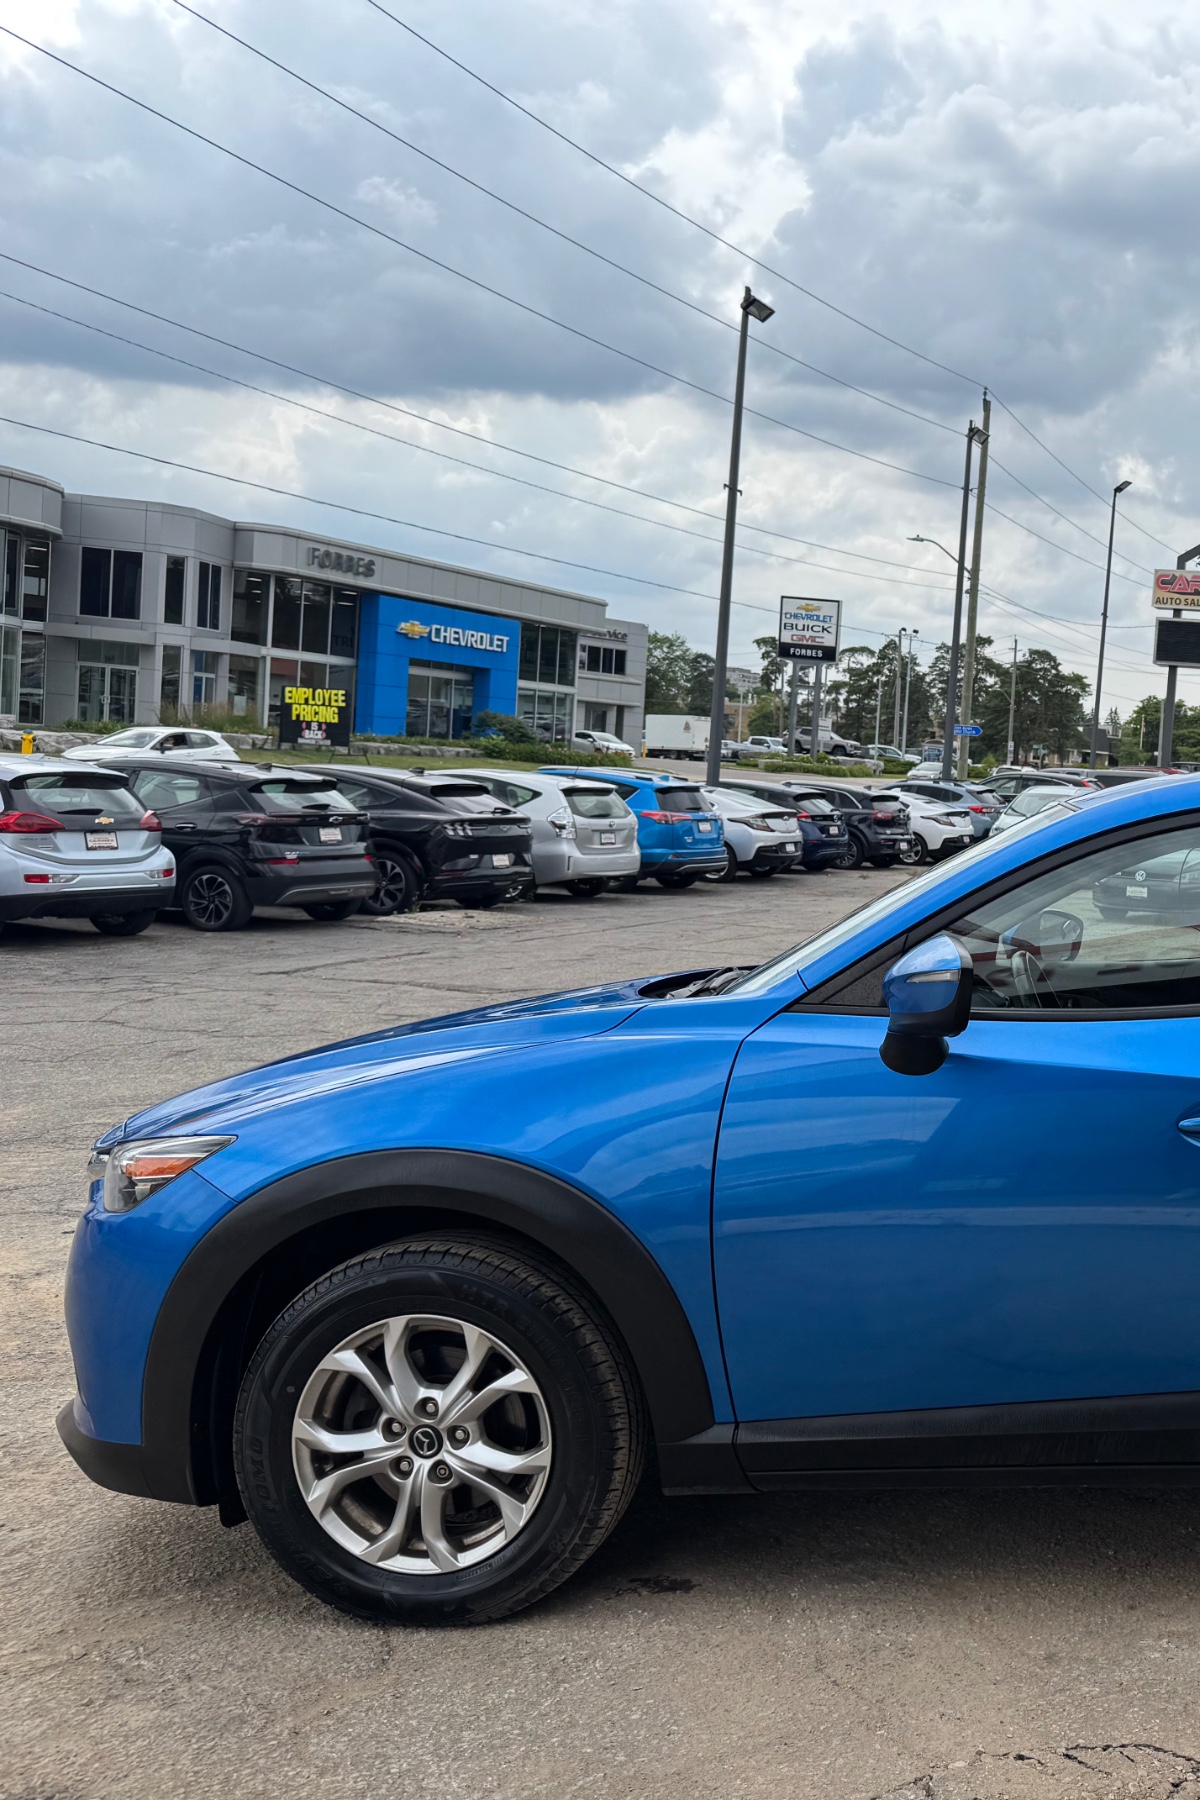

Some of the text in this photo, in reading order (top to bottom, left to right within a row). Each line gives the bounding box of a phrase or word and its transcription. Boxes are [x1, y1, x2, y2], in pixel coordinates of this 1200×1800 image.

[308, 547, 376, 578] FORBES
[1155, 597, 1182, 606] AUTO
[784, 612, 834, 623] CHEVROLET
[783, 622, 833, 634] BUICK
[430, 624, 510, 653] CHEVROLET
[791, 634, 825, 644] GMC
[790, 647, 823, 658] FORBES
[285, 687, 346, 707] EMPLOYEE
[292, 704, 339, 723] PRICING
